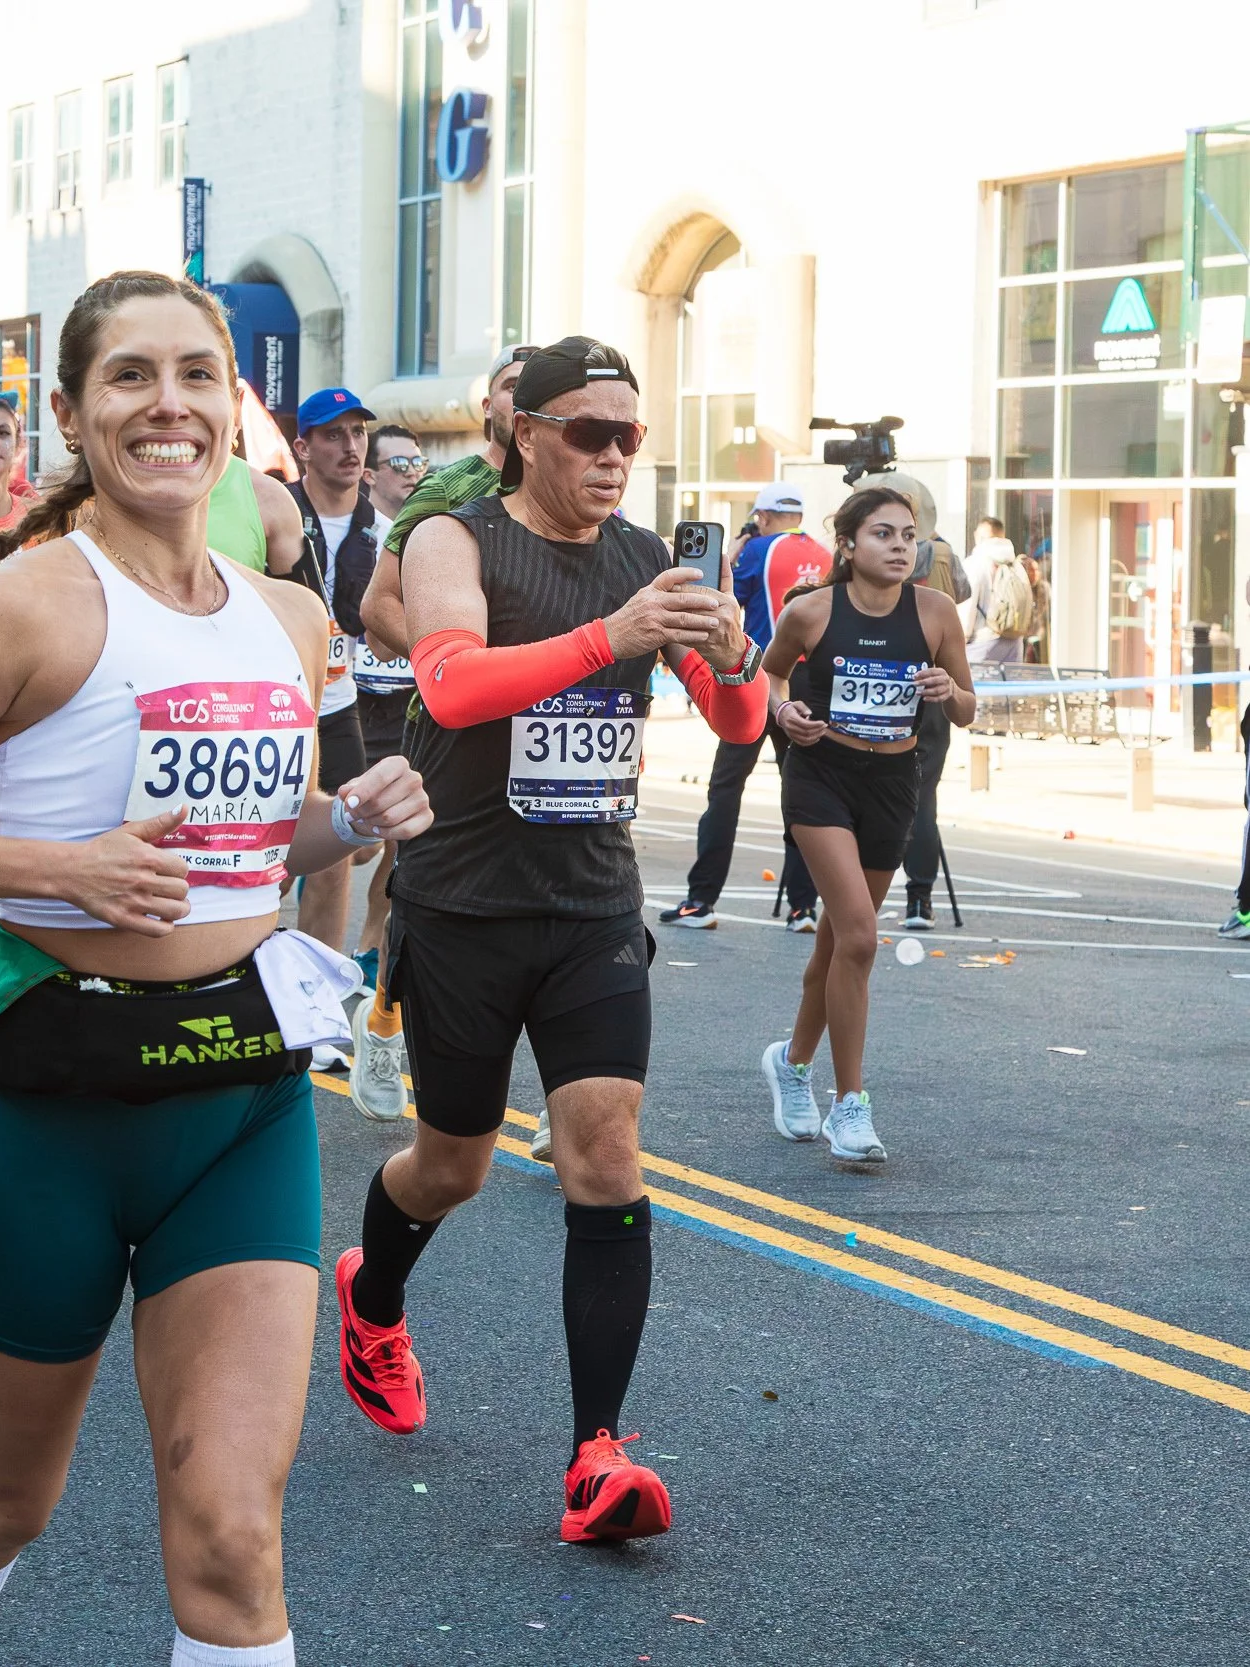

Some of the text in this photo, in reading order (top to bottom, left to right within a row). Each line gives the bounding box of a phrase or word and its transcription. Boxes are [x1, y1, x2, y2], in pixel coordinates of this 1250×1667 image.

[186, 184, 197, 250] movement
[265, 336, 277, 410] movement
[211, 693, 229, 702] TATA
[841, 680, 917, 706] 31329
[212, 703, 255, 713] CONSULTANCY
[268, 711, 298, 722] TATA
[212, 715, 240, 724] SERVICES
[525, 721, 636, 763] 31392
[144, 735, 305, 800] 38694
[190, 798, 262, 824] MARÍA
[534, 799, 542, 808] 3
[592, 800, 600, 809] C
[195, 857, 231, 866] CORRAL
[233, 854, 241, 868] F
[141, 1032, 283, 1065] HANKER
